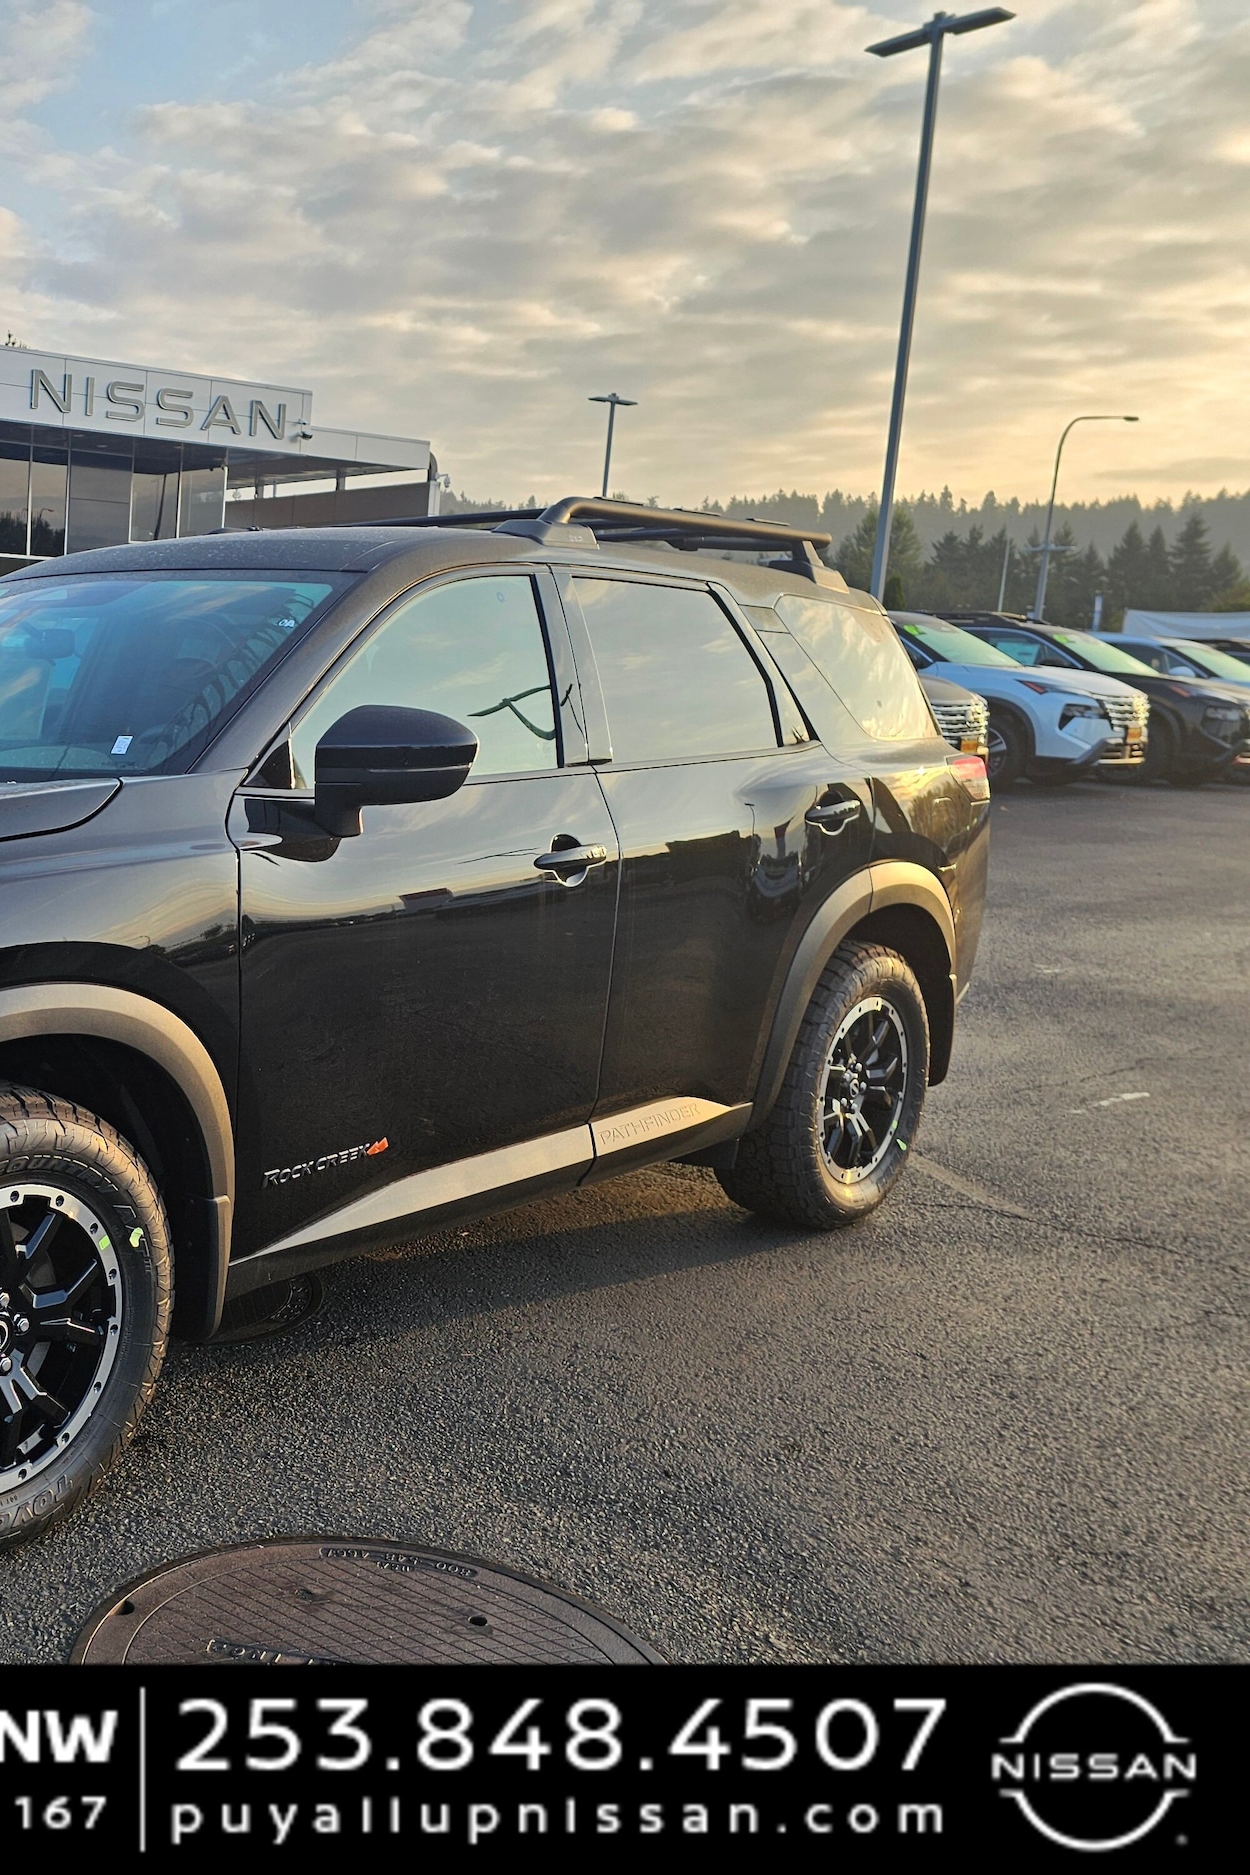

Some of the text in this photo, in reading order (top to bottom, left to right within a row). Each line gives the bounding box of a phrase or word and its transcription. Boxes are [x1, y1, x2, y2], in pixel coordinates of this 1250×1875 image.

[29, 368, 287, 440] NISSAN
[597, 1102, 702, 1145] PATHFINDER
[260, 1142, 370, 1189] ROCK CREEK
